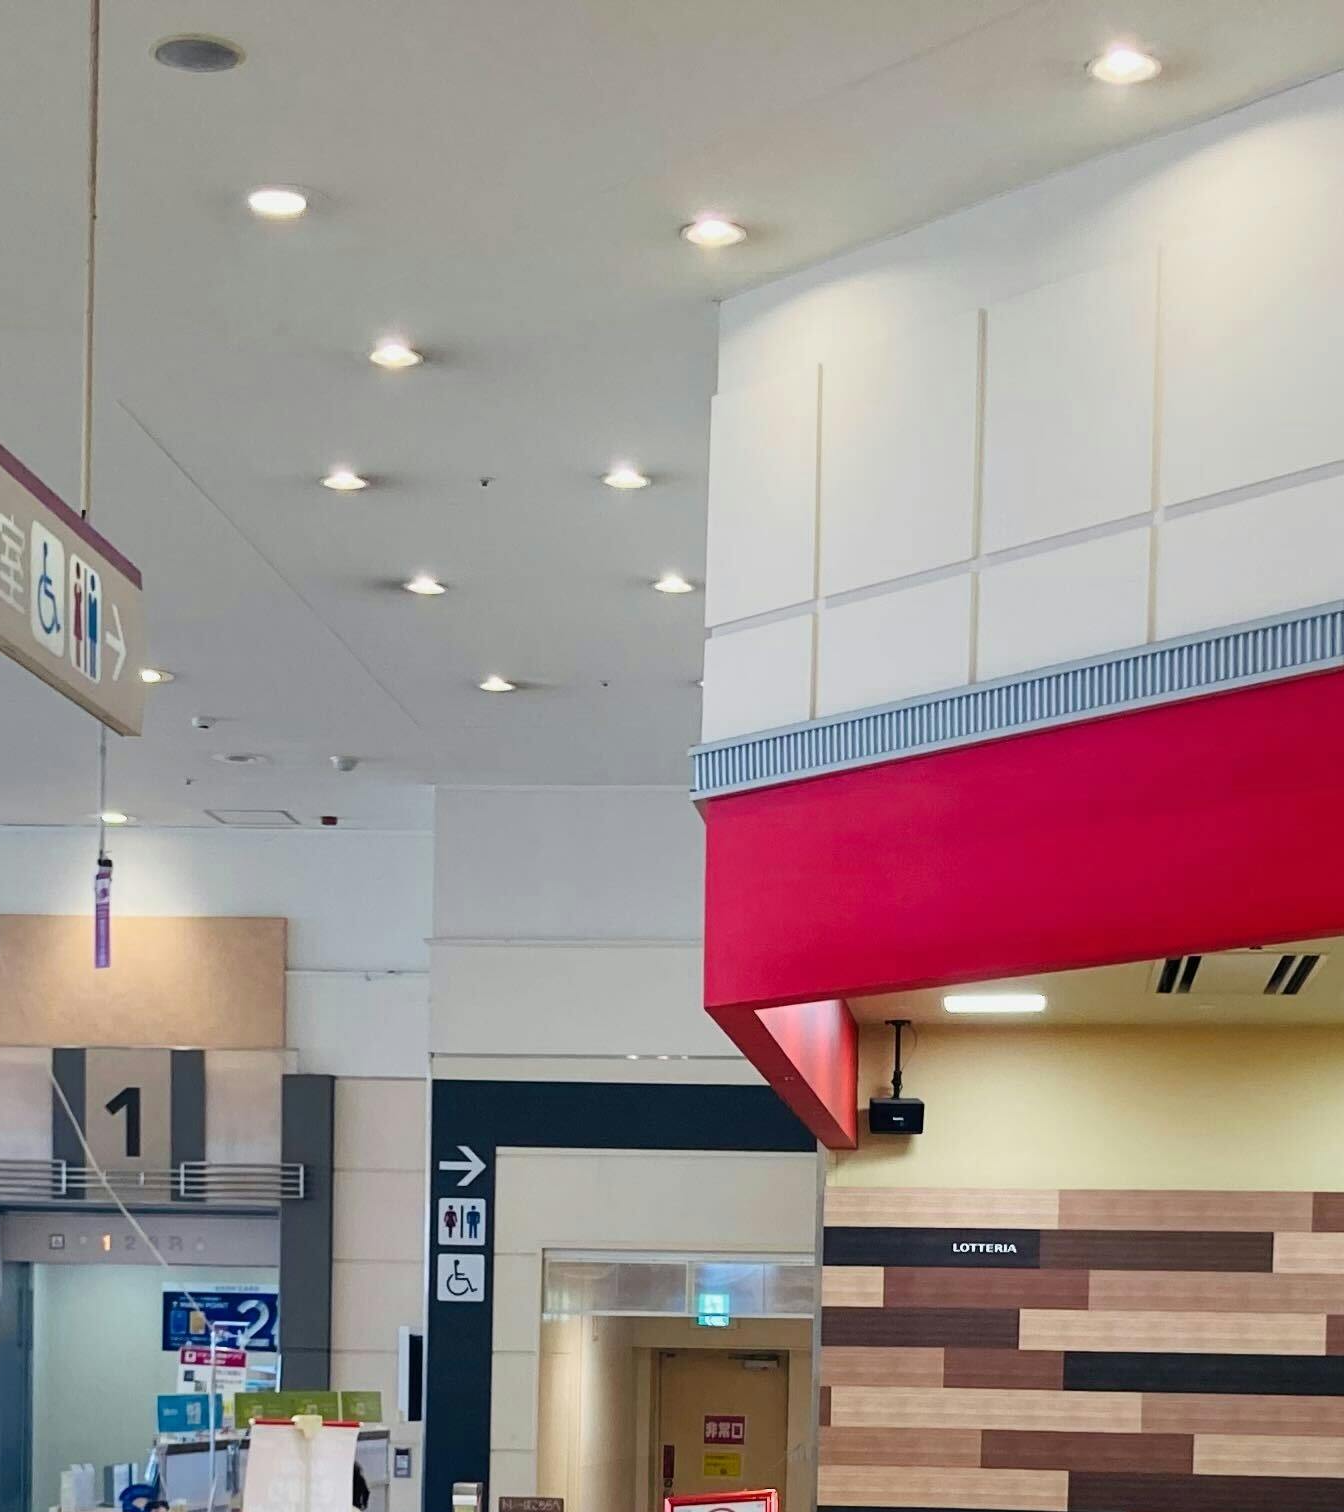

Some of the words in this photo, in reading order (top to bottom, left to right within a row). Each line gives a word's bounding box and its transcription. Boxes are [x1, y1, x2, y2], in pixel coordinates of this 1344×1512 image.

[105, 1086, 141, 1157] 1
[952, 1243, 1017, 1254] LOTTERIA
[706, 1421, 744, 1439] 非常口
